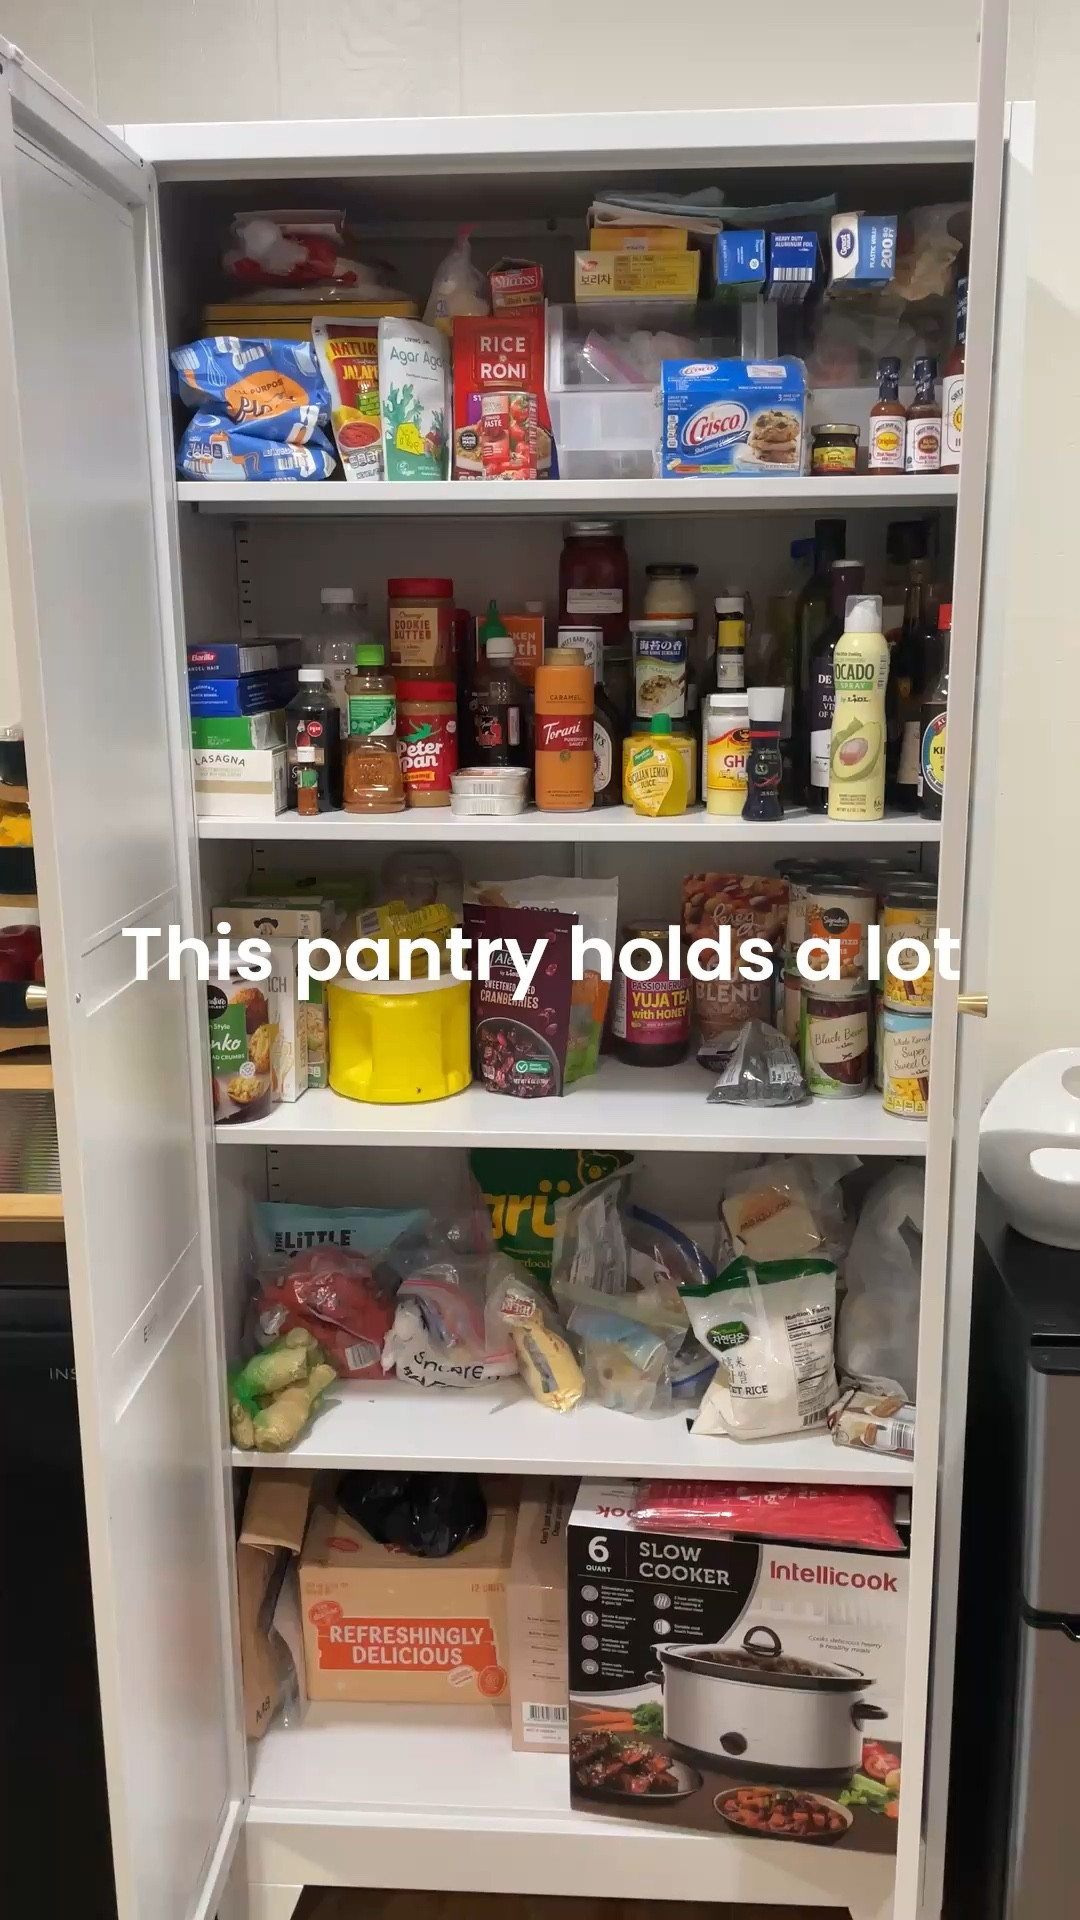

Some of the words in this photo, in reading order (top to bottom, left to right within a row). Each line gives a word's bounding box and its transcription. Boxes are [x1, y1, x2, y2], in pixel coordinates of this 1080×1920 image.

[881, 238, 894, 269] 200
[581, 273, 612, 286] 보리차
[480, 336, 526, 353] RICE
[390, 346, 420, 366] Agar
[480, 363, 527, 379] RONI
[484, 420, 502, 428] PASTE
[690, 414, 740, 446] Crisco
[394, 620, 430, 630] COOKIE
[191, 653, 216, 662] Barilla
[818, 674, 832, 684] DE
[543, 720, 582, 745] Torani
[398, 741, 444, 757] Peter
[194, 755, 246, 767] LASAGNA
[723, 755, 745, 768] GH
[650, 766, 669, 778] LEMON
[484, 979, 516, 993] SWEETENED
[631, 981, 666, 992] PASSION
[695, 983, 762, 1002] BLEND
[632, 990, 669, 1008] YUJA
[671, 989, 690, 1004] TEA
[632, 1009, 654, 1019] with
[656, 1007, 686, 1019] HONEY
[213, 1023, 231, 1031] Style
[815, 1031, 841, 1046] Black
[901, 1046, 925, 1059] Super
[894, 1058, 919, 1071] Sweet
[785, 1311, 811, 1321] Nutrition
[811, 1306, 830, 1314] Facts
[745, 1384, 769, 1396] RICE
[588, 1535, 610, 1563] 6
[639, 1542, 702, 1562] SLOW
[586, 1564, 612, 1573] QUART
[638, 1562, 730, 1586] COOKER
[769, 1560, 899, 1593] Intellicook
[330, 1625, 485, 1645] REFRESHINGLY
[352, 1646, 463, 1665] DELICIOUS
